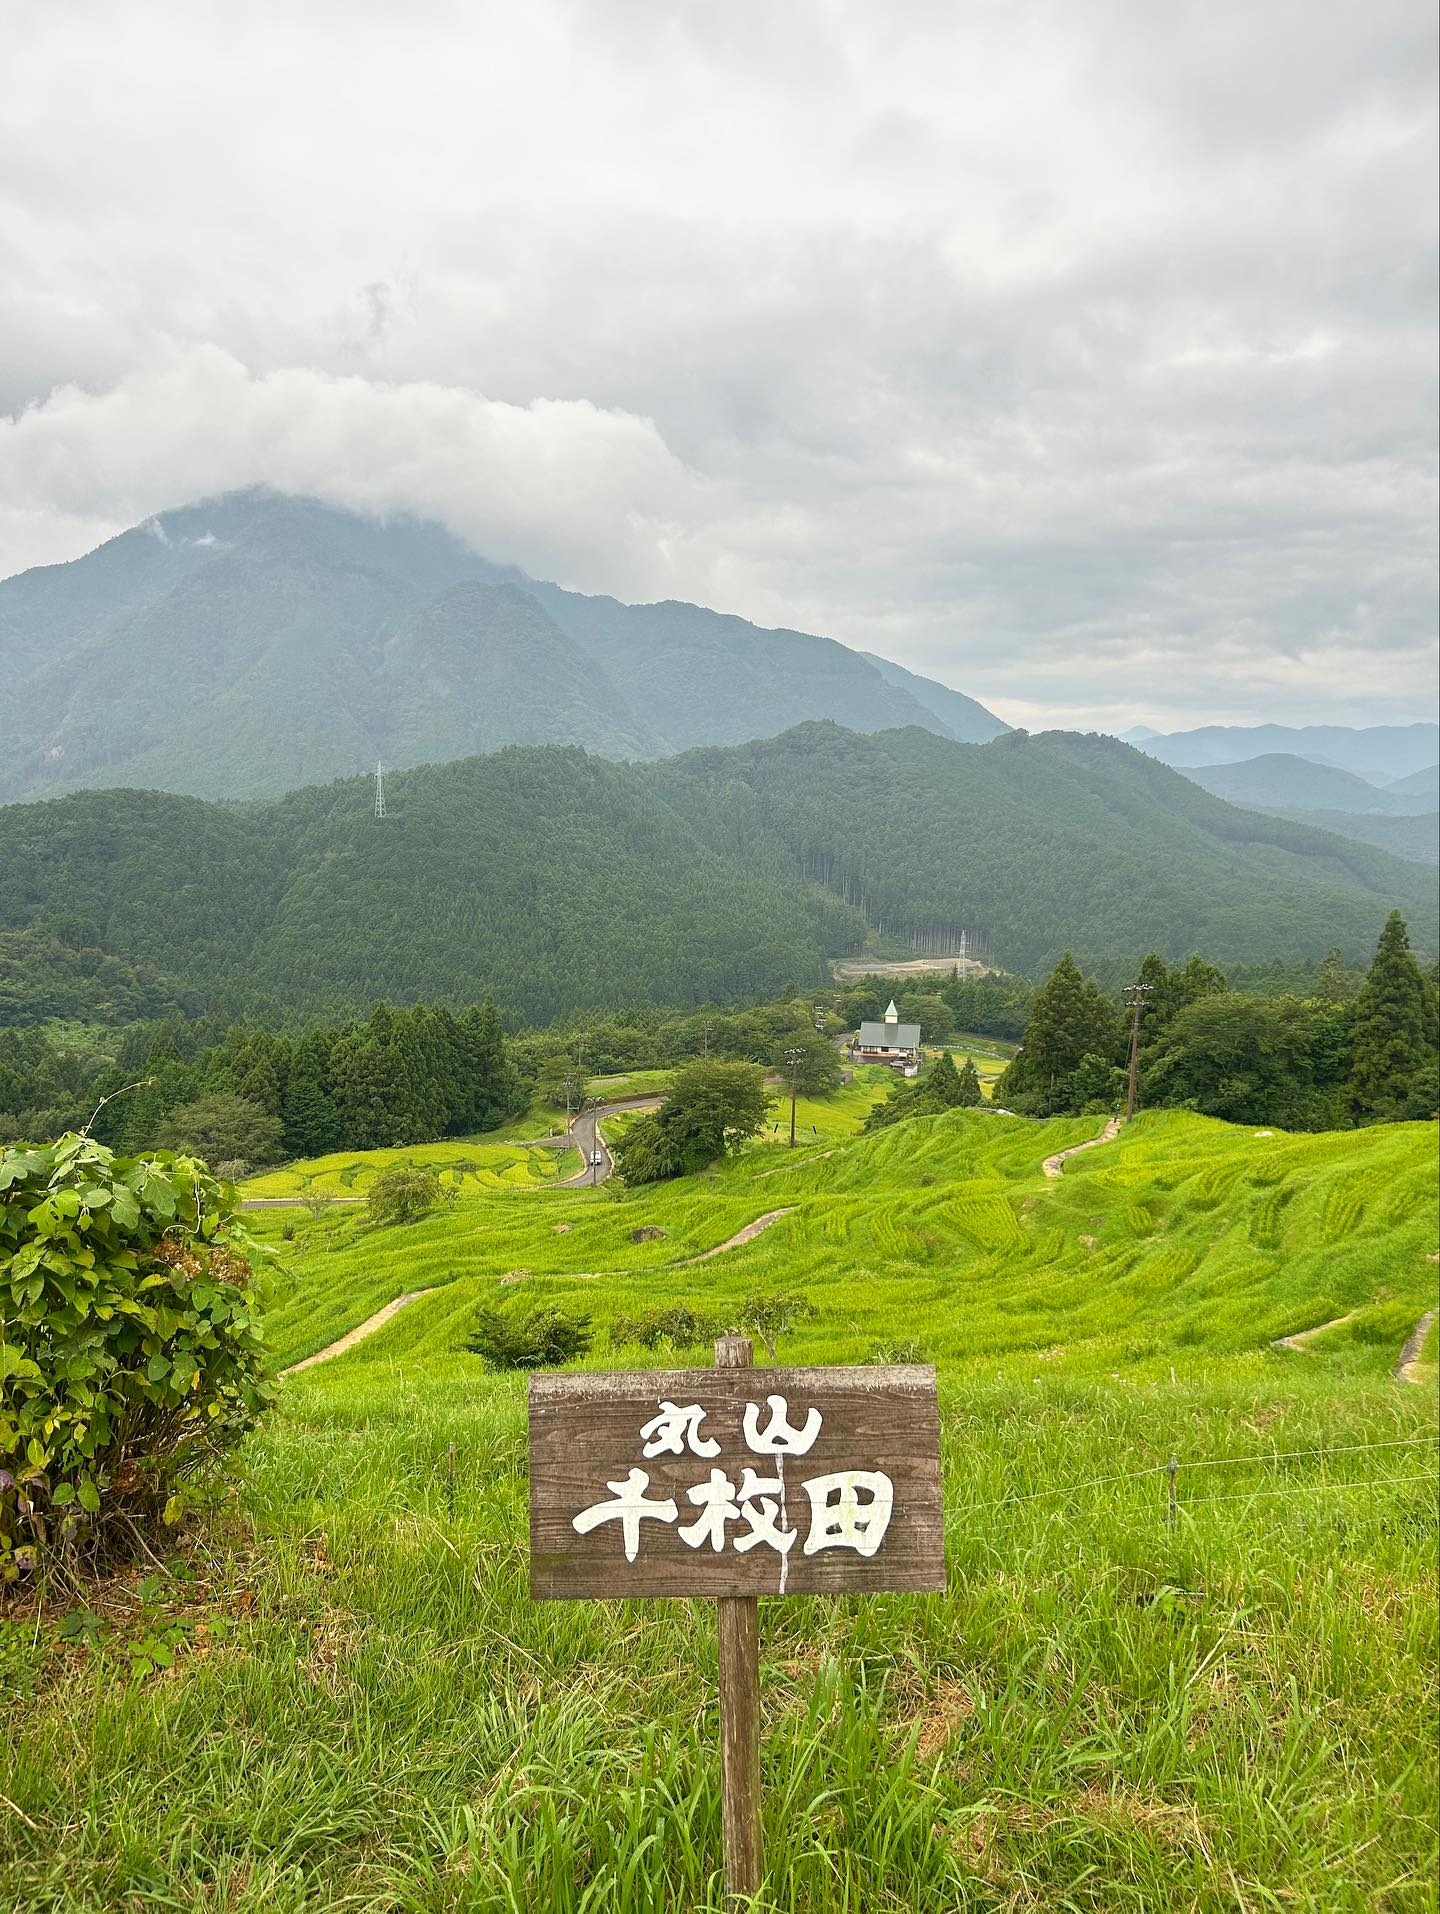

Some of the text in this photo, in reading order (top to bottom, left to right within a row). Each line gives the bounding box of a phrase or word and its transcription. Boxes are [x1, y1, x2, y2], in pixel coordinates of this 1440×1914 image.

[639, 1394, 823, 1459] 丸山
[571, 1467, 894, 1564] 千枚田
